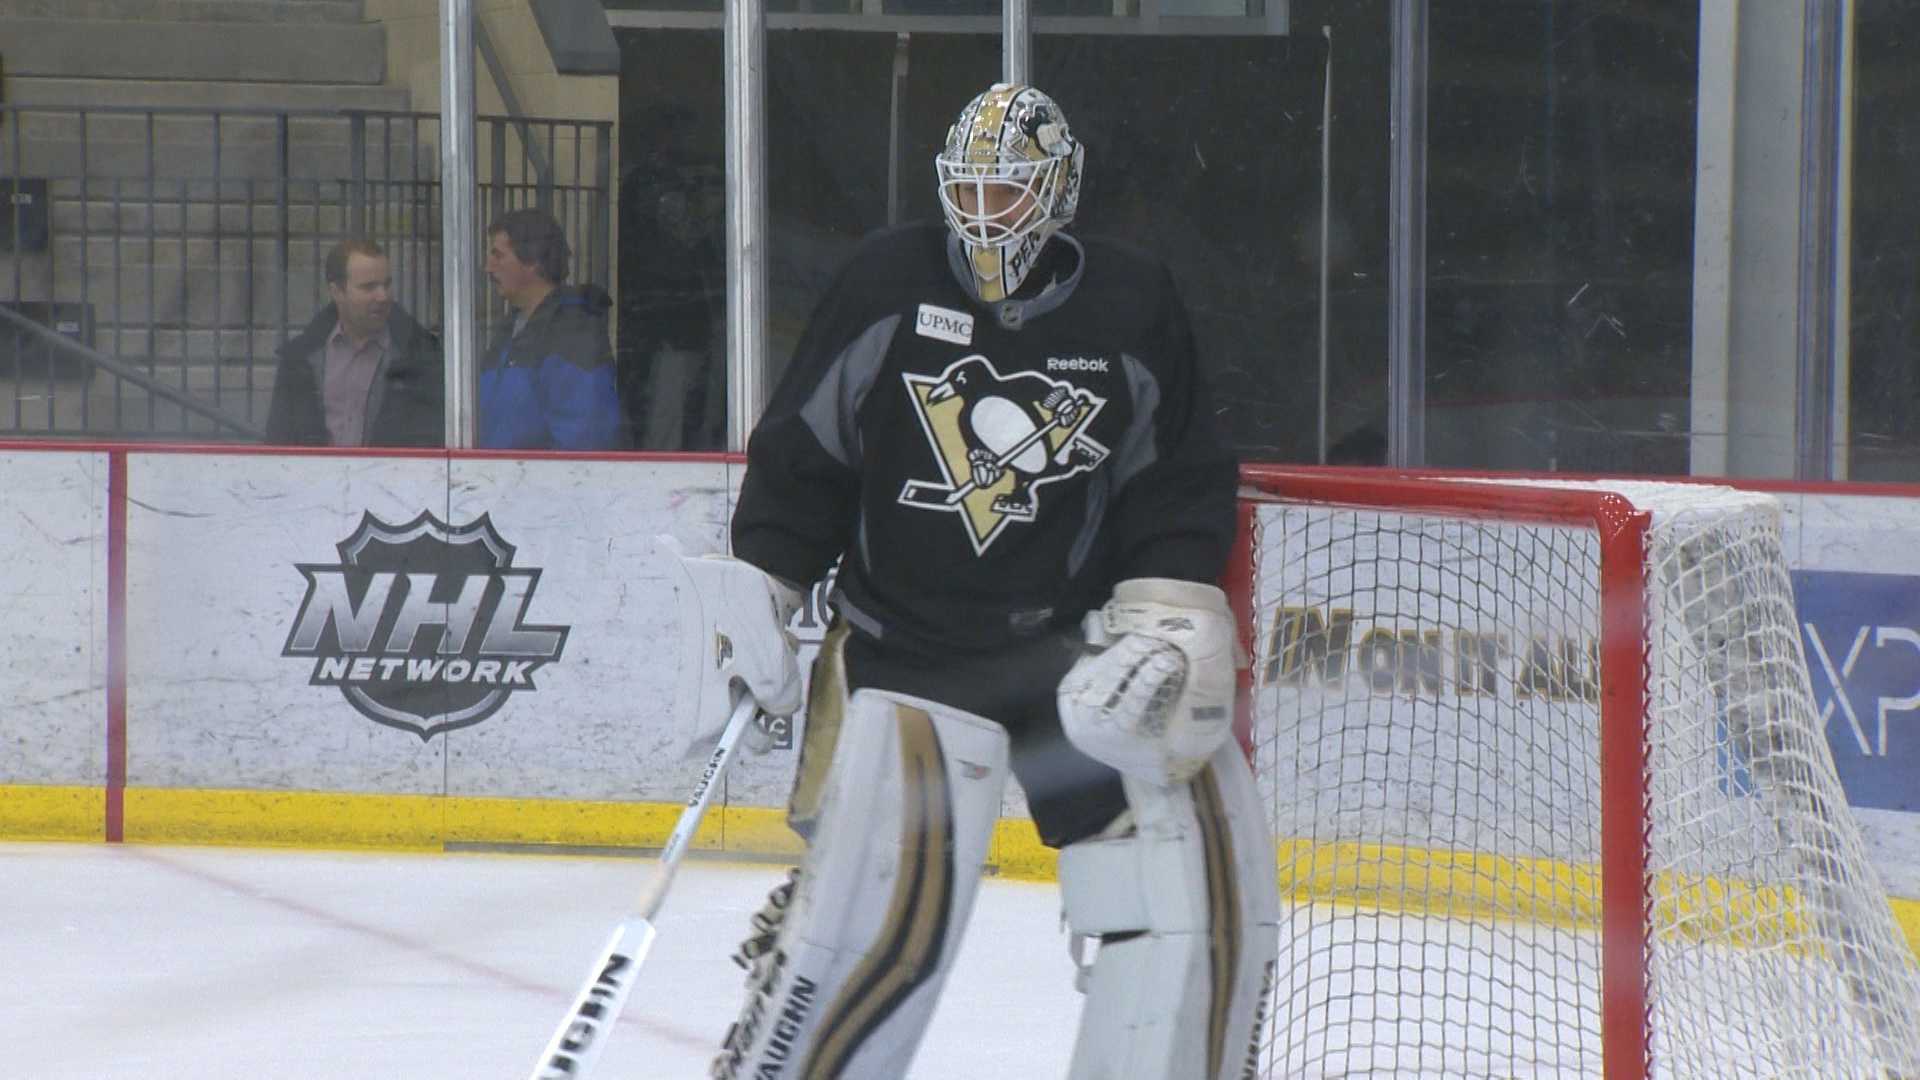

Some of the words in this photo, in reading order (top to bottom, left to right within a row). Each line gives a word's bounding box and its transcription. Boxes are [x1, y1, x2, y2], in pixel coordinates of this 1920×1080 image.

[919, 312, 972, 338] UPMC
[1047, 357, 1109, 373] Reebok
[288, 568, 564, 657] NHL
[318, 656, 533, 685] NETWORK
